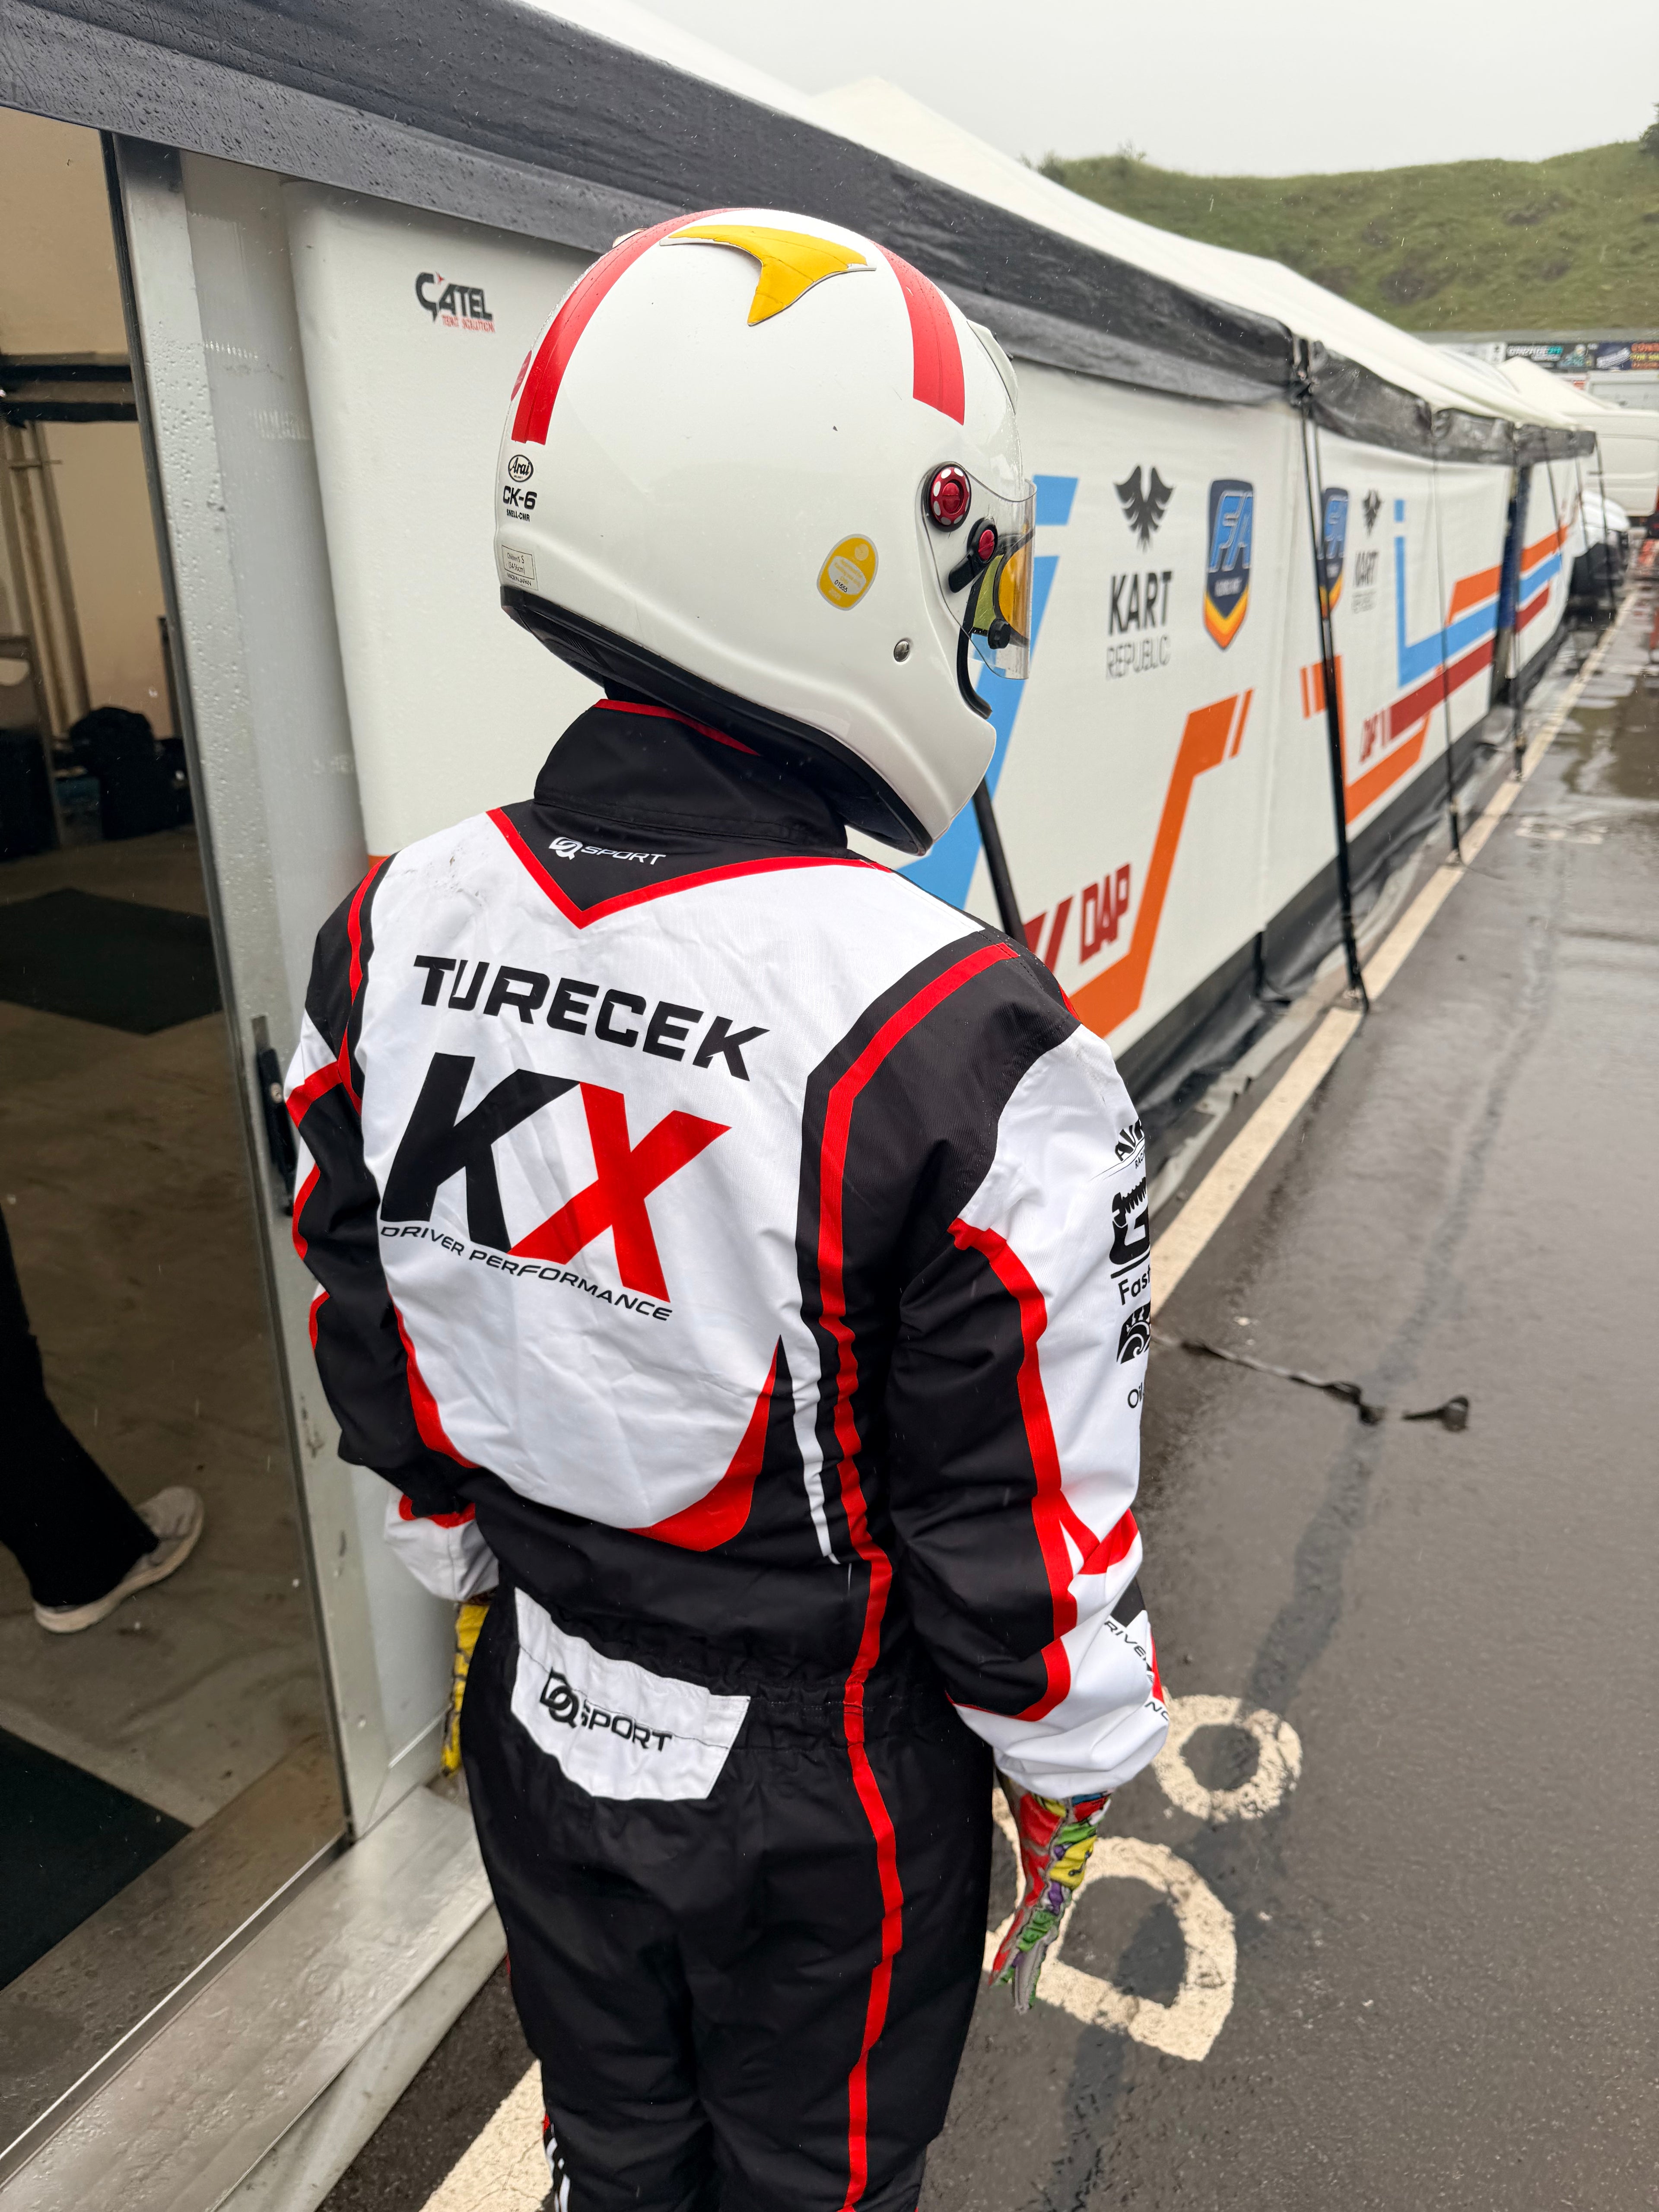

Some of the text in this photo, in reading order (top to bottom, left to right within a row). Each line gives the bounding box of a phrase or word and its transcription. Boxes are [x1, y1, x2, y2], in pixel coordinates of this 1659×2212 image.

[509, 457, 531, 476] Arai
[503, 485, 537, 510] CK-6
[1108, 570, 1173, 636] KART
[1106, 635, 1171, 680] REPUBLIC
[581, 846, 667, 865] SPORT
[1080, 863, 1131, 965] DAP
[413, 955, 770, 1082] TURECEK
[380, 1052, 732, 1303] KX
[380, 1226, 673, 1322] DRIVER PERFORMANCE
[1104, 1620, 1147, 1661] RIVE
[581, 1699, 672, 1752] SPORT
